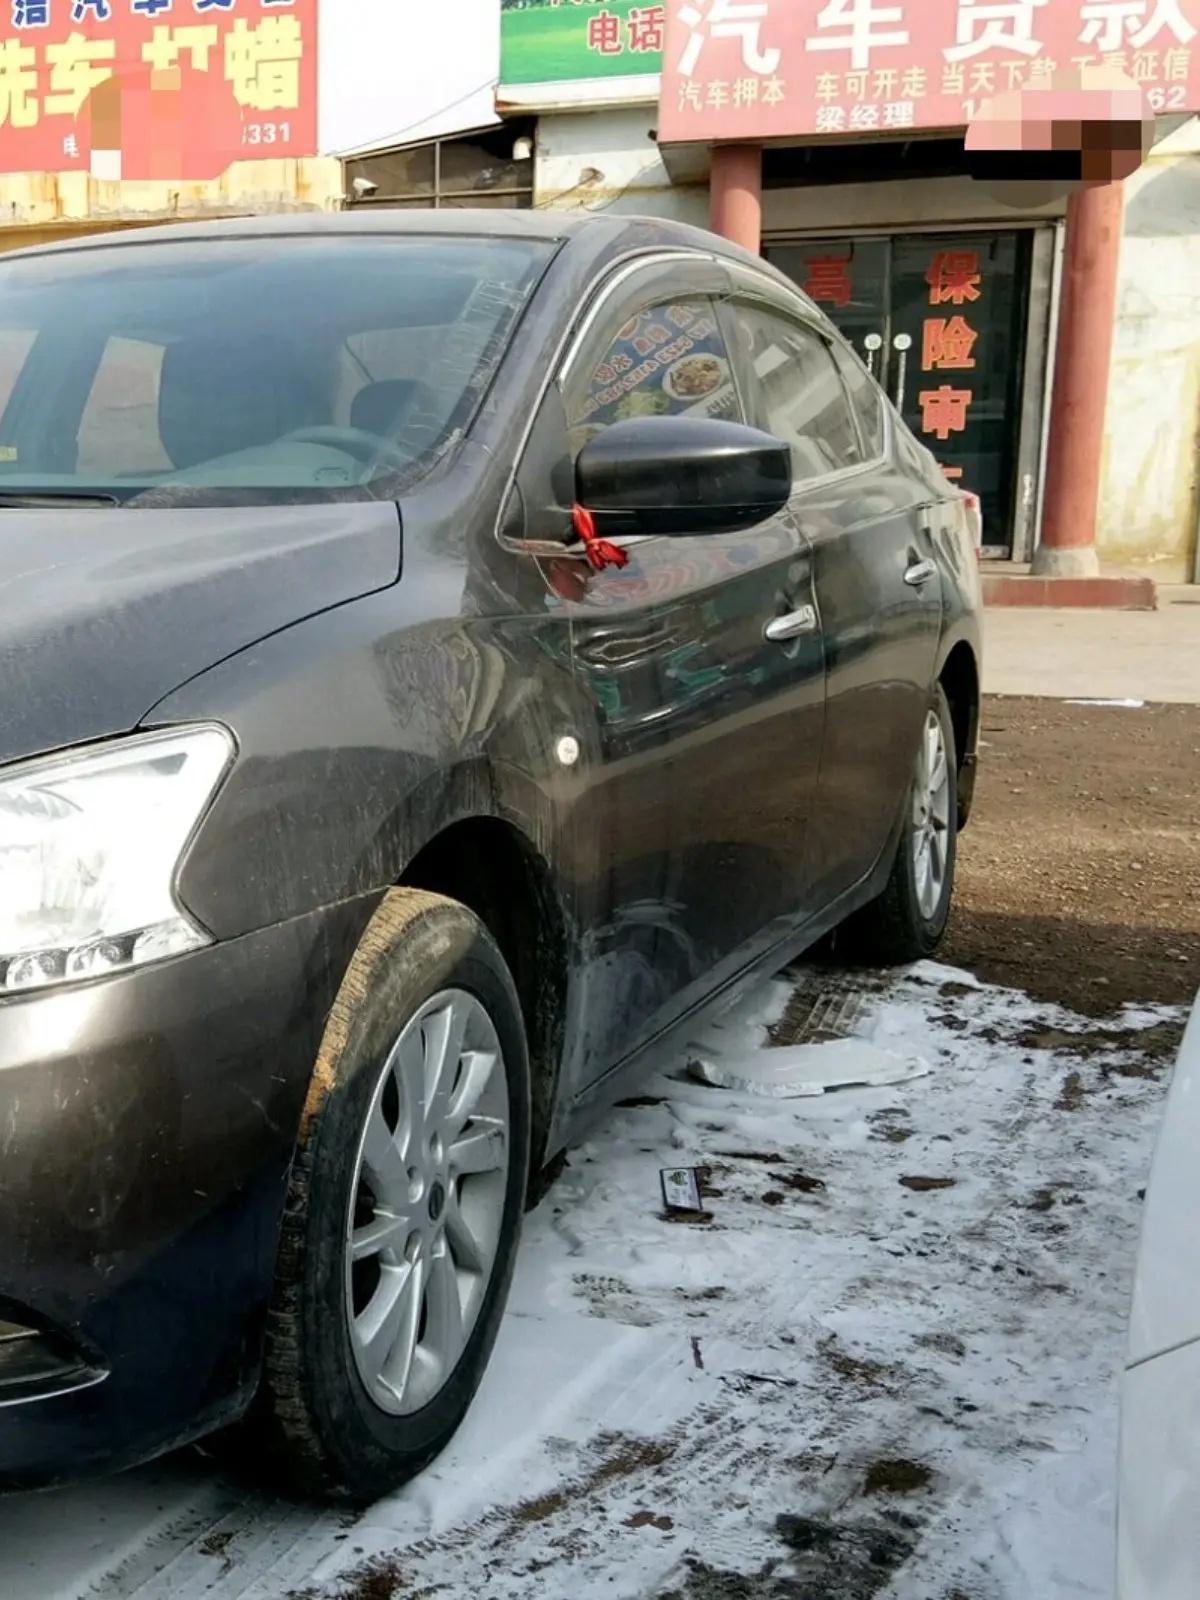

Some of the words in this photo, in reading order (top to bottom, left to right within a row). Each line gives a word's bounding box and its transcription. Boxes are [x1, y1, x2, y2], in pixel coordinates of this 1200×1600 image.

[589, 8, 664, 54] 电话
[816, 66, 927, 102] 车可开走
[816, 101, 914, 132] 梁经理
[918, 251, 981, 478] 保险审
